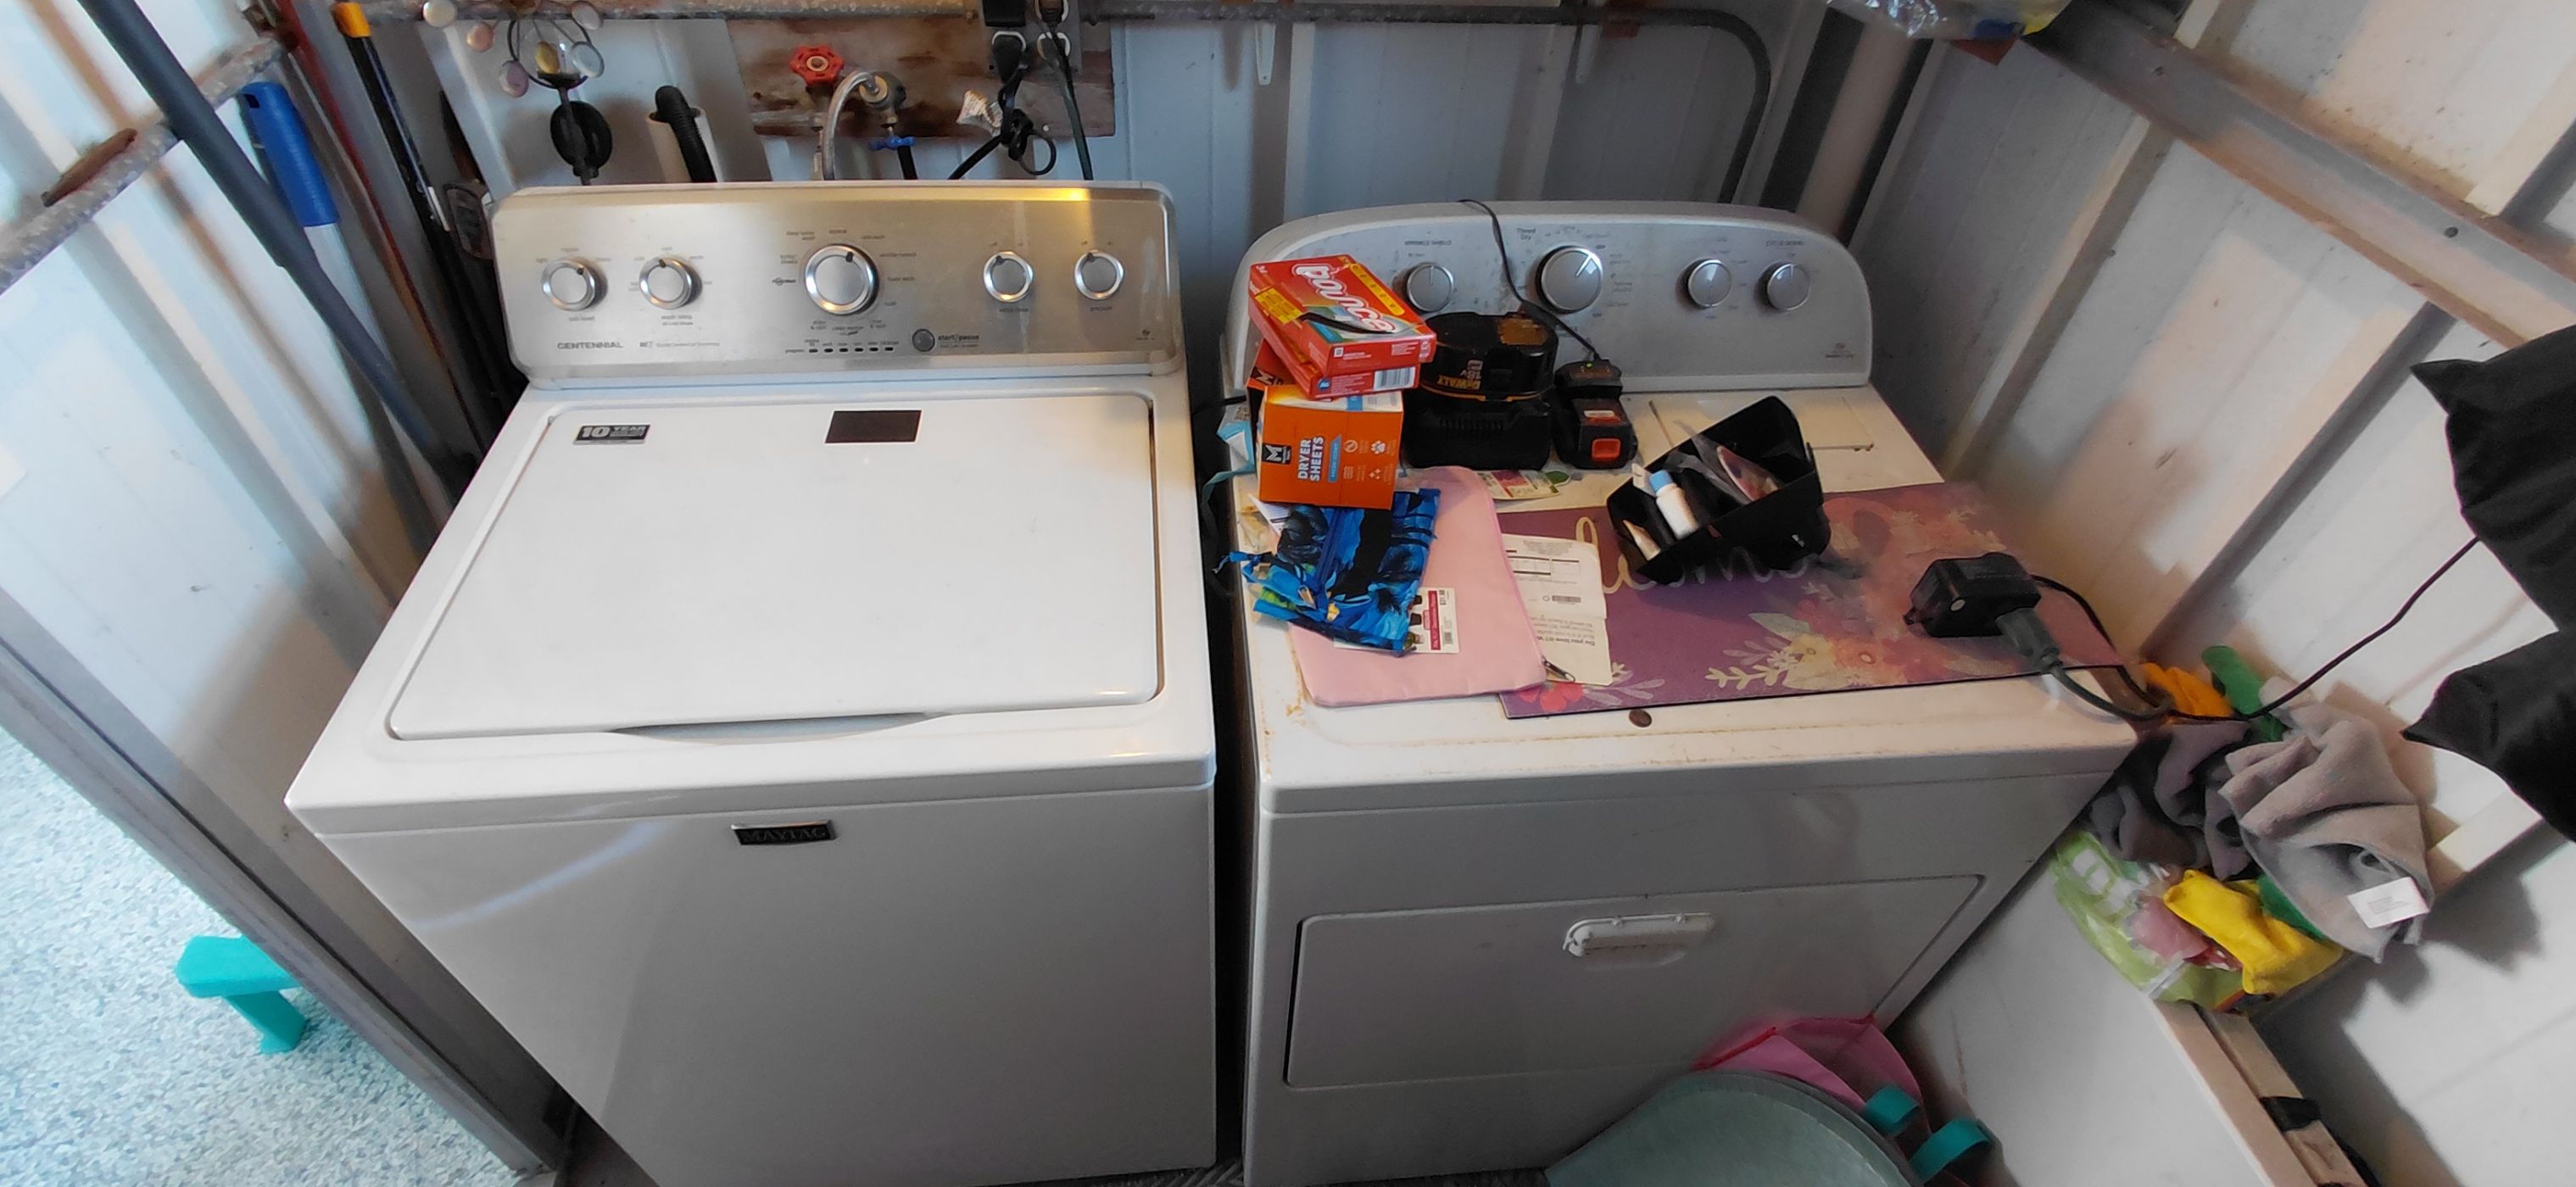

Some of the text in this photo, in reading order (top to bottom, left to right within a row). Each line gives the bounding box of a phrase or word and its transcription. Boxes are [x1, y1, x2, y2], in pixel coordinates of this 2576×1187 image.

[582, 426, 611, 438] 10
[1297, 439, 1312, 480] DRYER
[1309, 437, 1324, 482] SHEETS
[739, 826, 828, 843] MAYTAG
